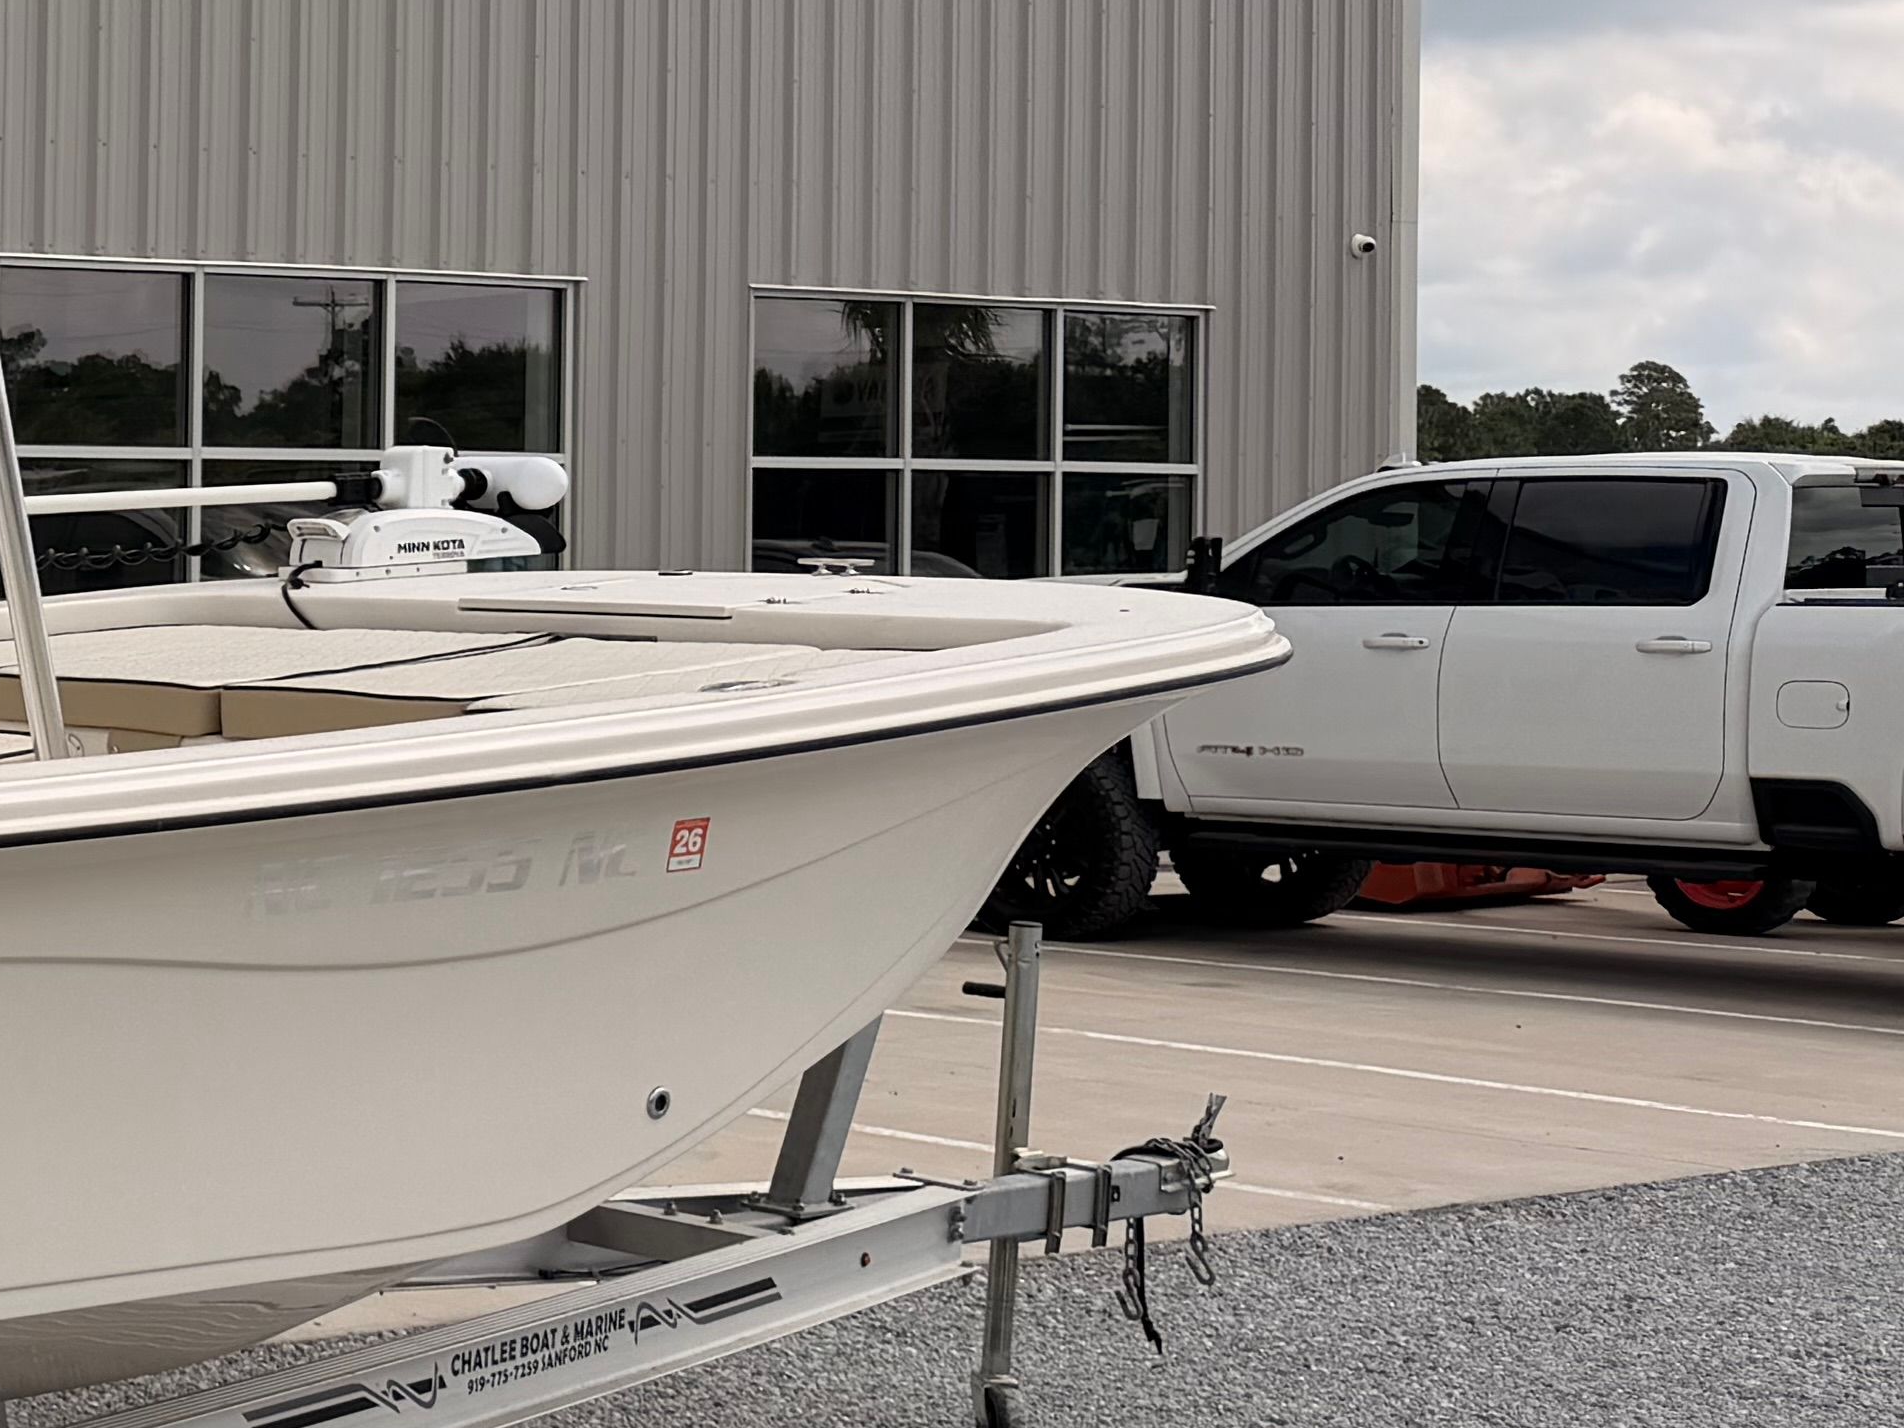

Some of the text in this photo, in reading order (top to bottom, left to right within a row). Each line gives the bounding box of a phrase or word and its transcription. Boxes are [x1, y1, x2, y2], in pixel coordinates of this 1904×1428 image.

[397, 539, 465, 553] MINN KOTA
[673, 828, 704, 854] 26
[451, 1308, 626, 1377] CHATLEE BOAT & MARINE
[541, 1343, 592, 1371] SANFORD
[593, 1335, 610, 1355] NC
